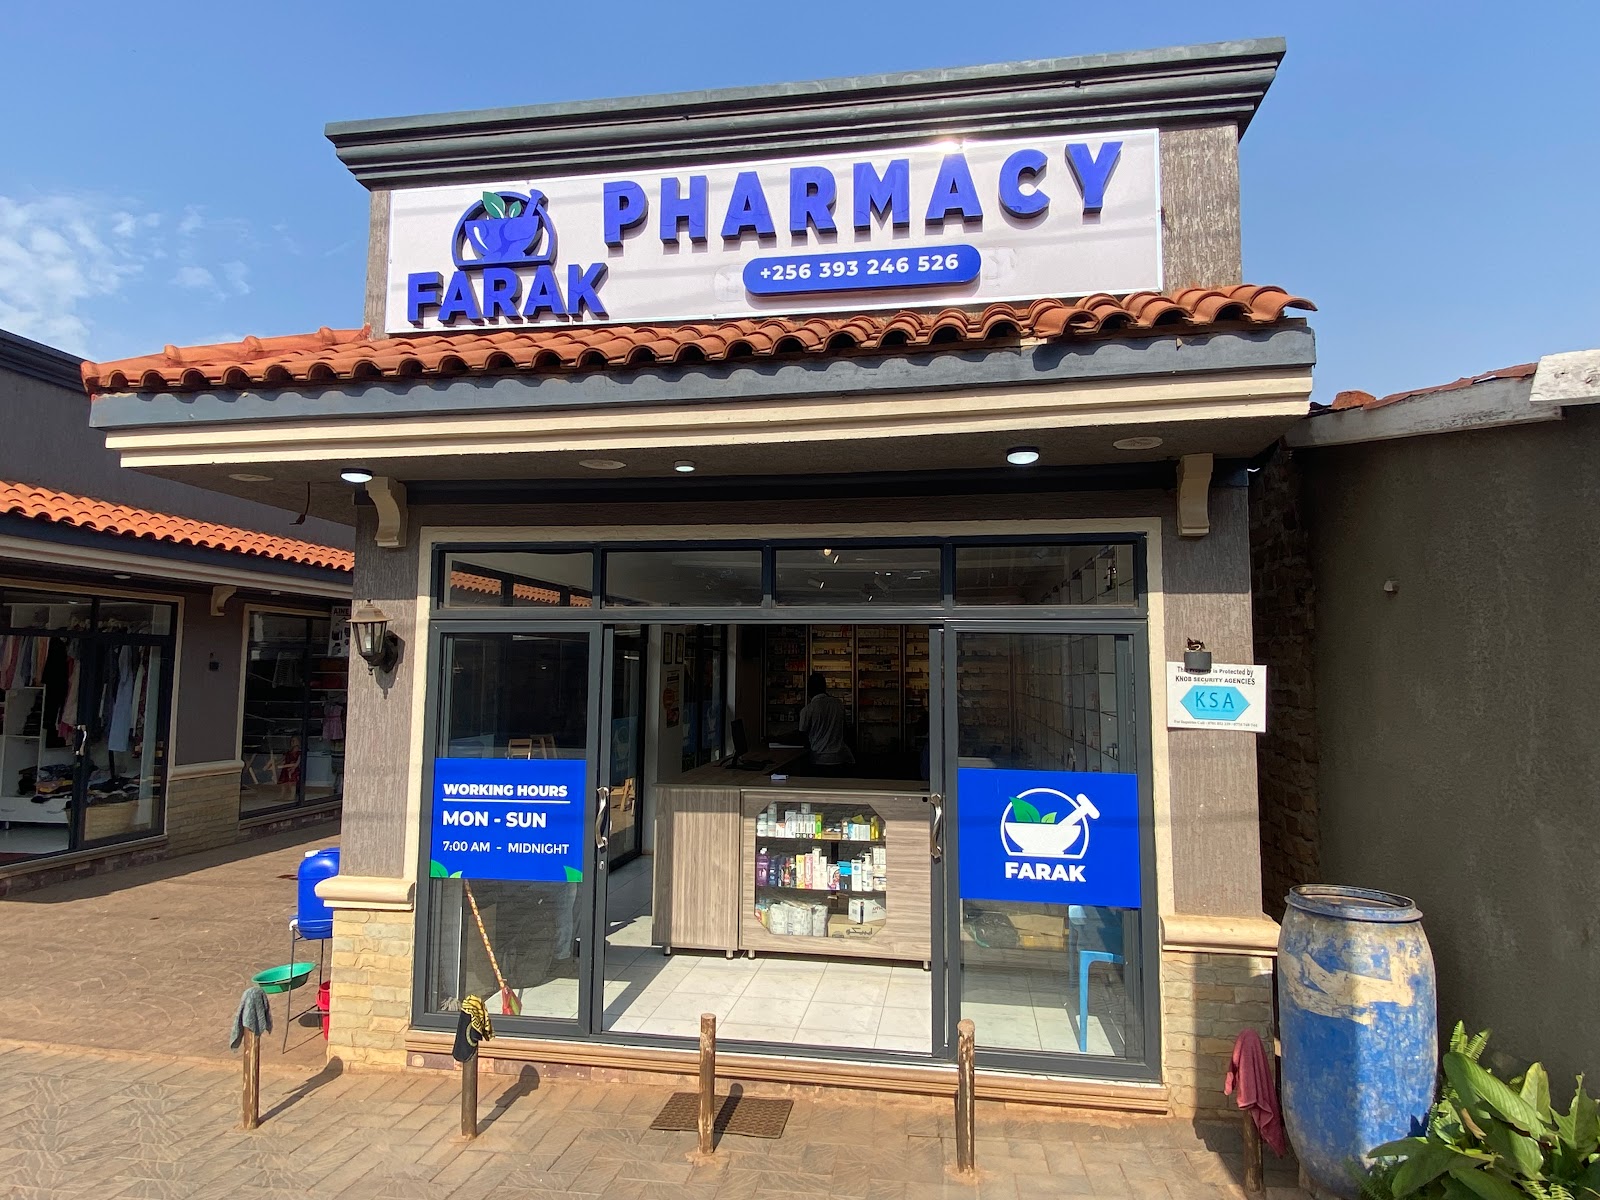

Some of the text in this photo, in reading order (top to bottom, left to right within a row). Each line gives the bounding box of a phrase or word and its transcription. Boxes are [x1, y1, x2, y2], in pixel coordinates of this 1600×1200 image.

[603, 141, 1123, 247] PHARMACY
[760, 253, 958, 281] +256 393 246 526
[408, 262, 609, 328] FARAK
[1247, 669, 1254, 677] by
[1195, 691, 1234, 709] KSA
[443, 784, 568, 797] WORKING HOURS
[442, 810, 489, 827] MON
[505, 812, 547, 828] SUN
[442, 841, 469, 852] 7:00
[470, 842, 491, 852] AM
[507, 843, 570, 855] MIDNIGHT
[1005, 862, 1086, 882] FARAK
